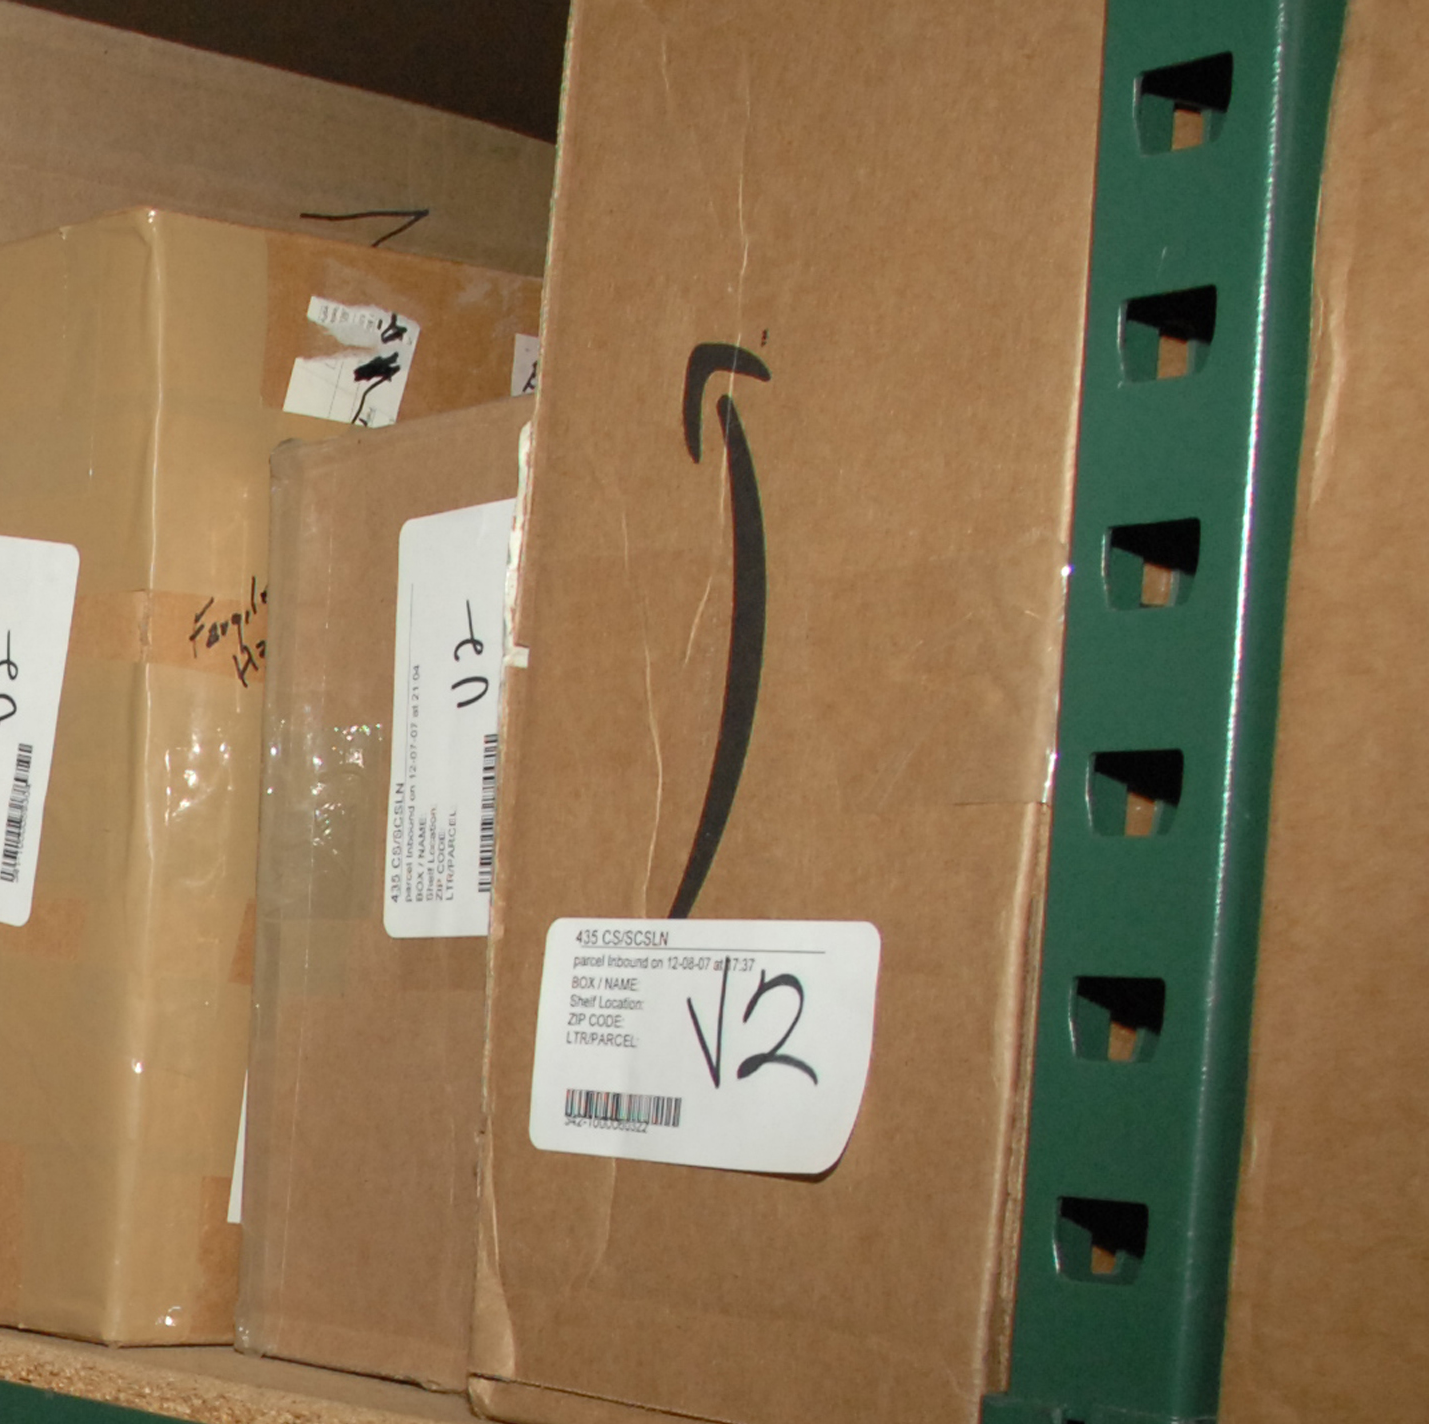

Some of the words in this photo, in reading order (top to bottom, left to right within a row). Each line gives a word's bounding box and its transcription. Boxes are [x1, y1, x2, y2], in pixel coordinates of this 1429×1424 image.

[410, 785, 415, 801] on
[390, 873, 401, 903] 435
[416, 871, 424, 902] BOX
[575, 929, 599, 946] 435
[602, 929, 668, 948] CS/SCSLN
[573, 955, 604, 970] parcel
[650, 958, 663, 970] on
[667, 956, 710, 972] 12-08-07
[571, 975, 596, 990] BOX
[570, 994, 596, 1009] Shelf
[567, 1013, 586, 1027] ZIP
